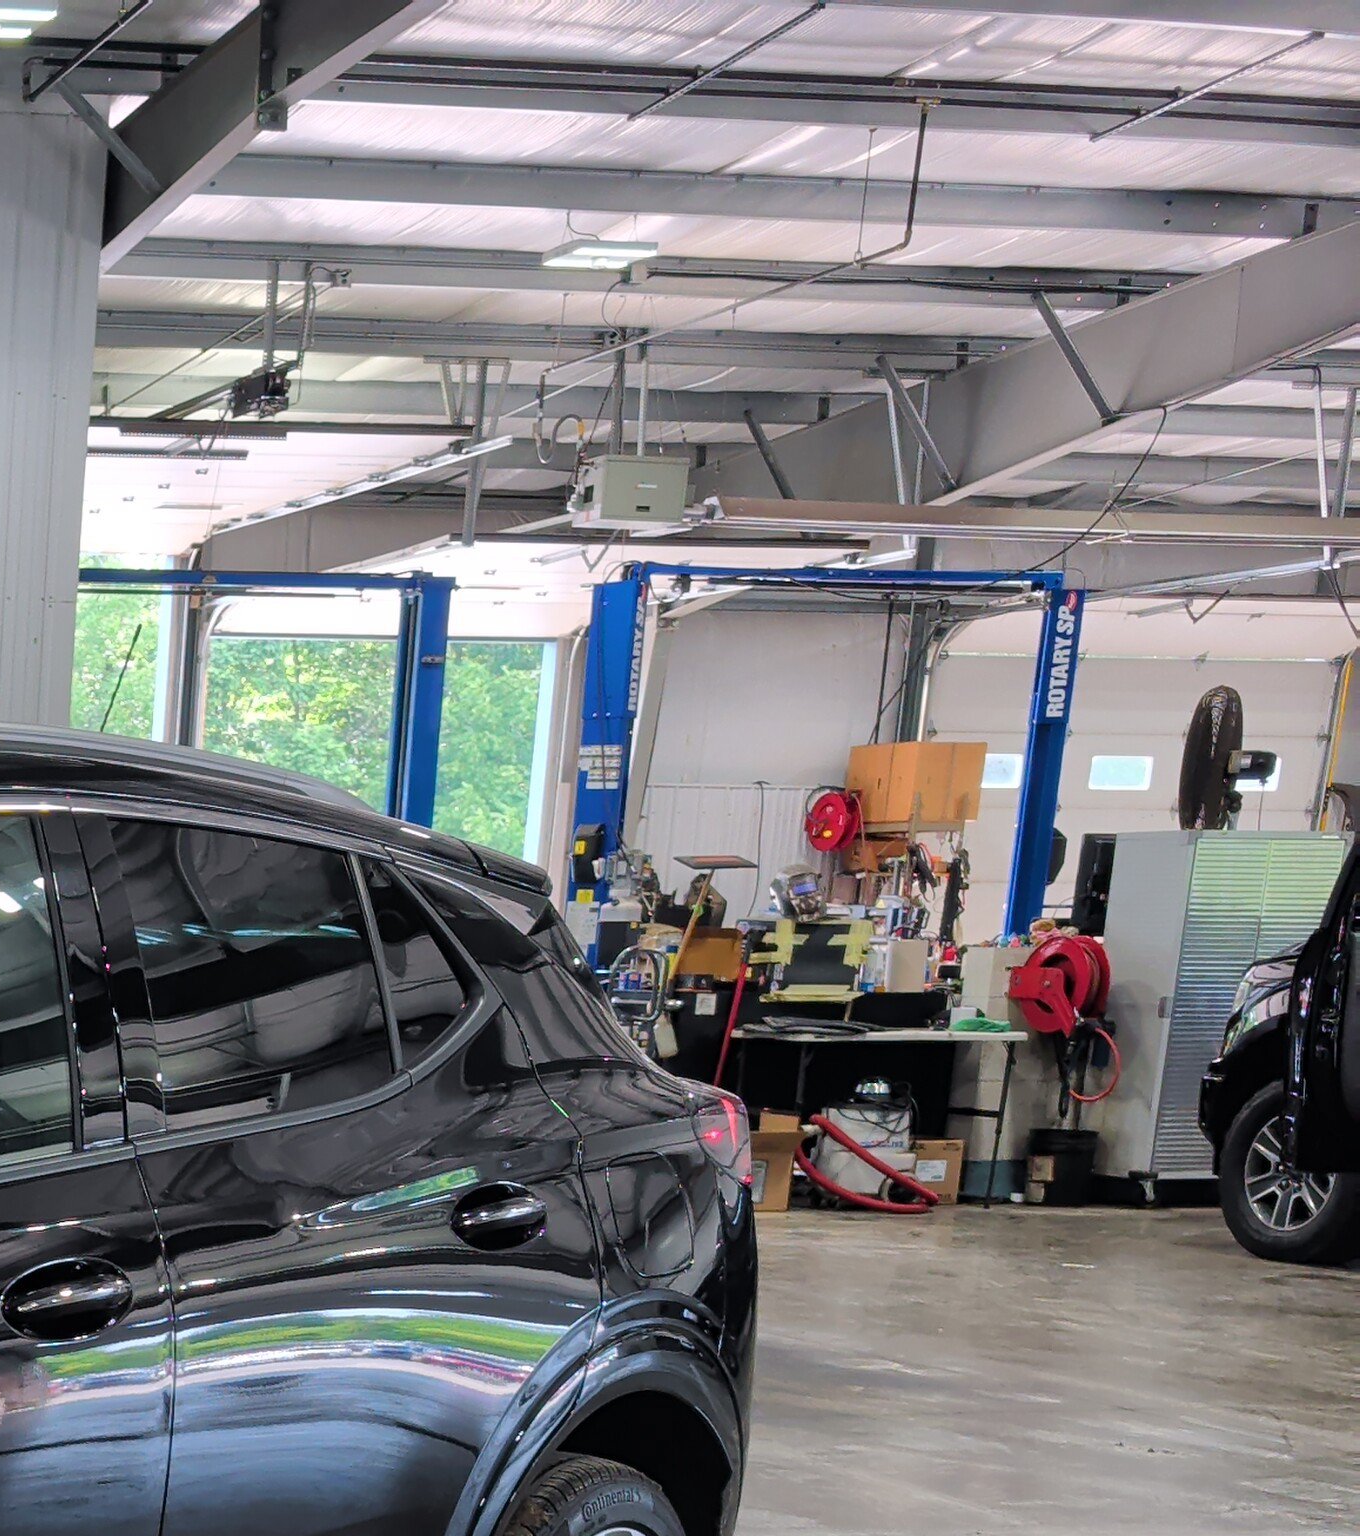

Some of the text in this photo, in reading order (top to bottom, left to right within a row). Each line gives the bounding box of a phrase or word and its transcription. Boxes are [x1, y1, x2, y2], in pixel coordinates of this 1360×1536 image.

[1056, 605, 1076, 635] SP
[628, 629, 644, 711] ROTARY
[1046, 636, 1073, 718] ROTARY
[582, 1488, 634, 1522] Continental
